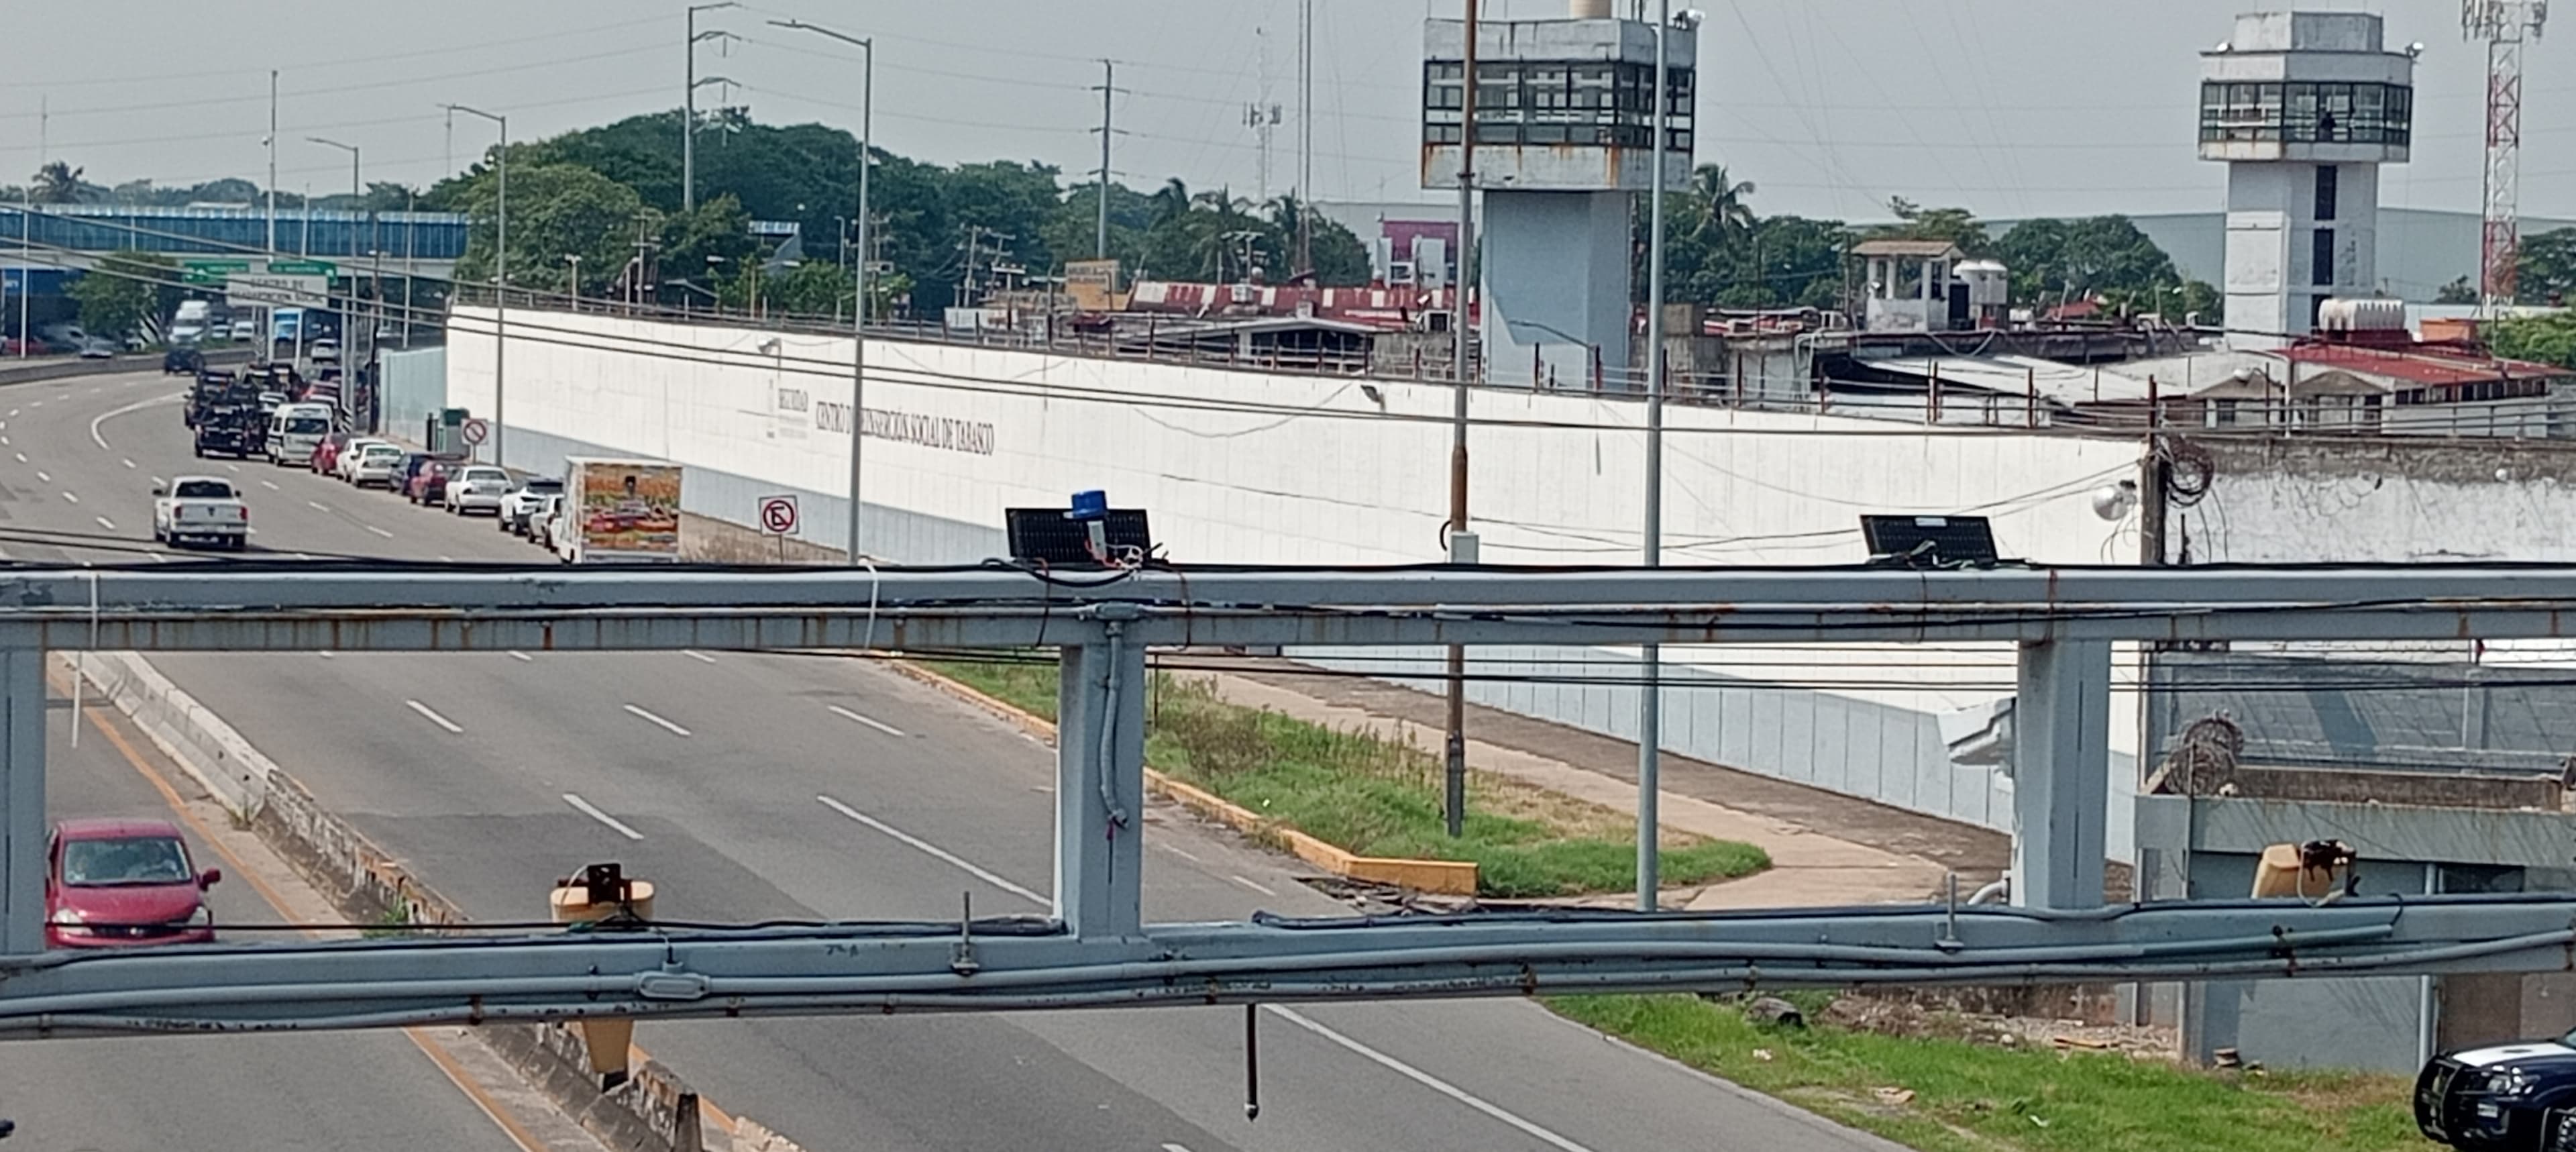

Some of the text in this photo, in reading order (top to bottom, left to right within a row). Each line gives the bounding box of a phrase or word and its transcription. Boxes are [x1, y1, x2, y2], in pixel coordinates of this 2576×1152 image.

[816, 401, 845, 432] CENTRO
[910, 413, 939, 448] SOCIAL
[942, 417, 953, 450] DE
[956, 420, 994, 456] TABASCO
